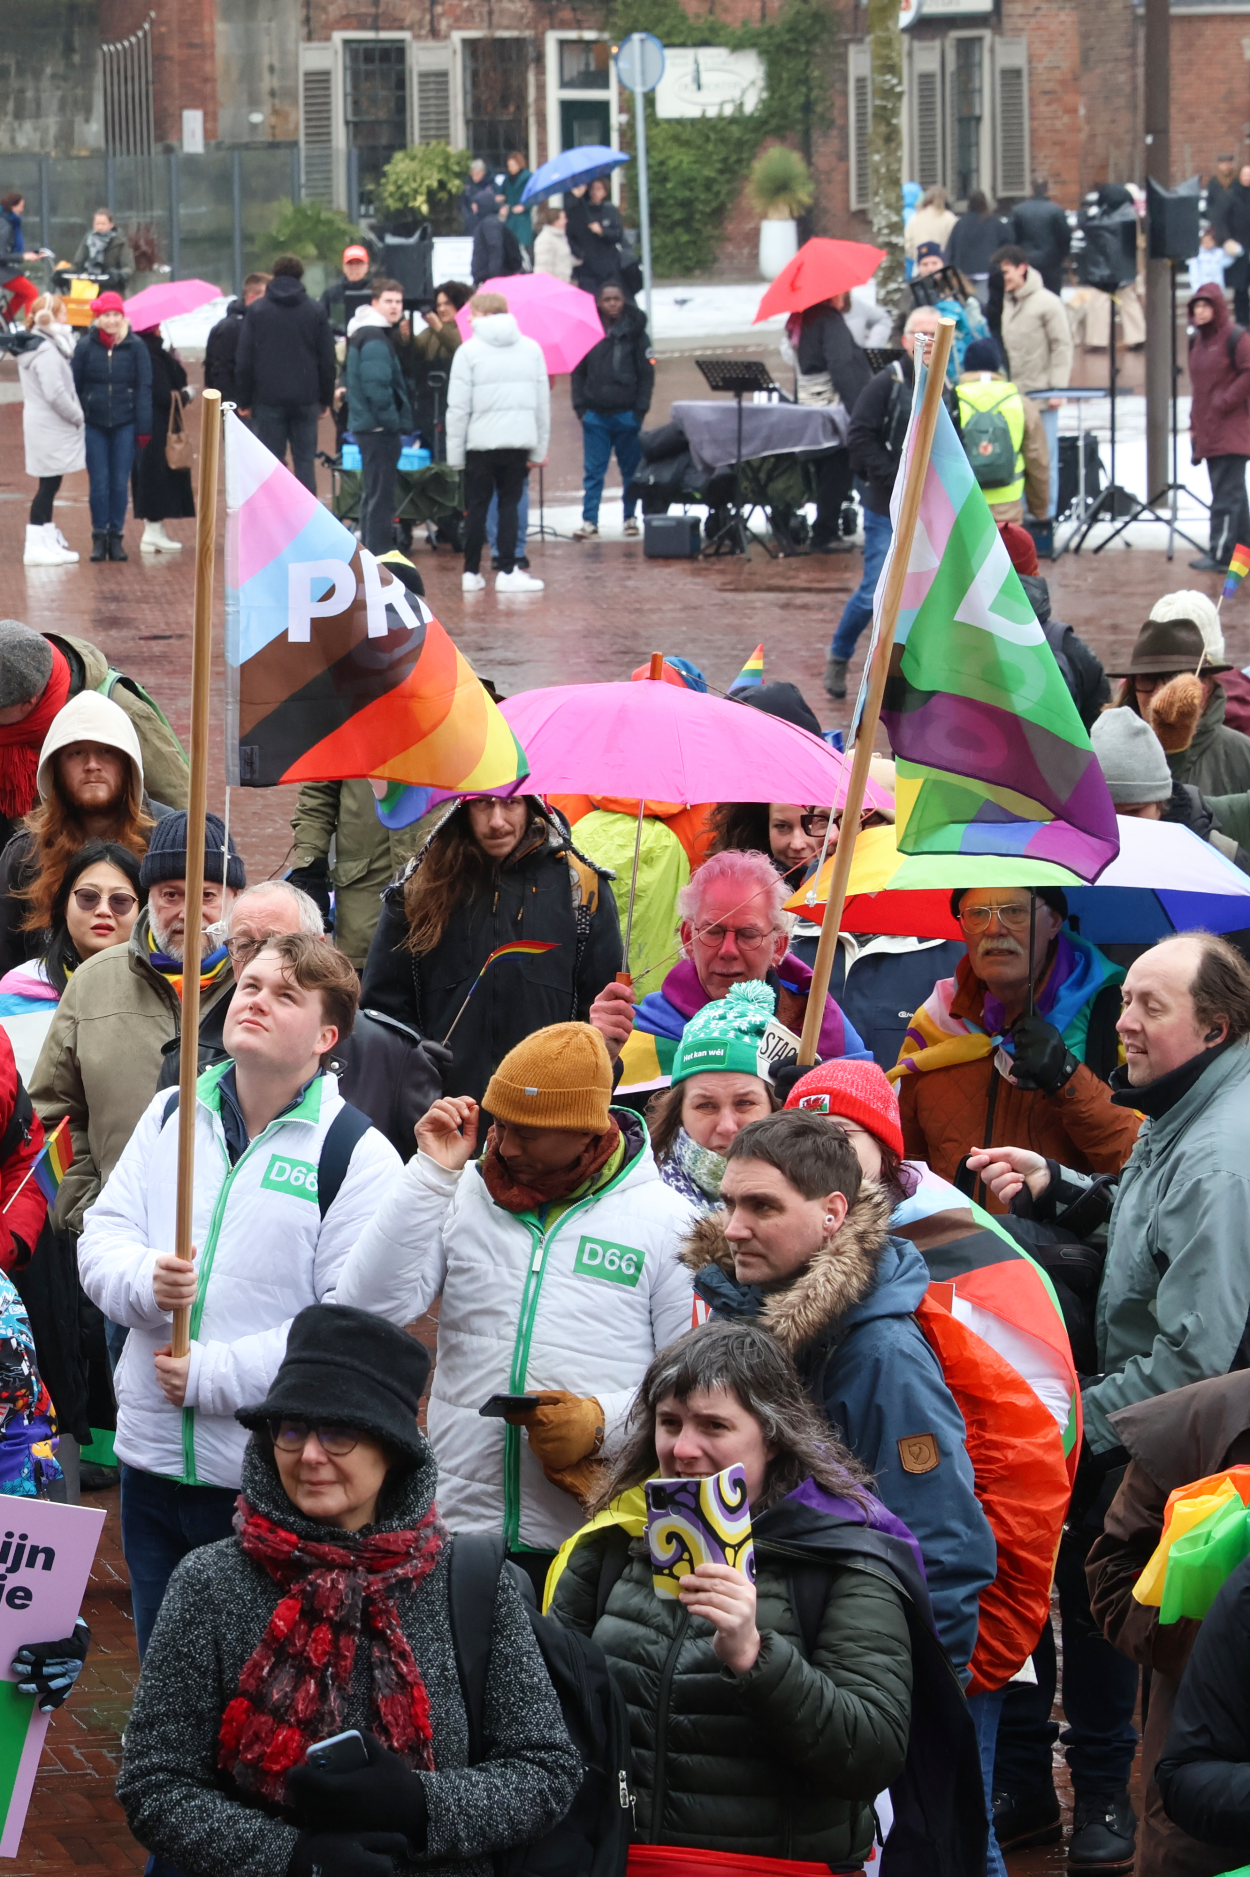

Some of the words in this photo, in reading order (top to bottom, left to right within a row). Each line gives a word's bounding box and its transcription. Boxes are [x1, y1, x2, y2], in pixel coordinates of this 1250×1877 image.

[683, 1053, 694, 1062] Het
[694, 1050, 707, 1058] kan
[708, 1048, 725, 1056] wél
[269, 1161, 318, 1192] D66
[582, 1242, 638, 1275] D66
